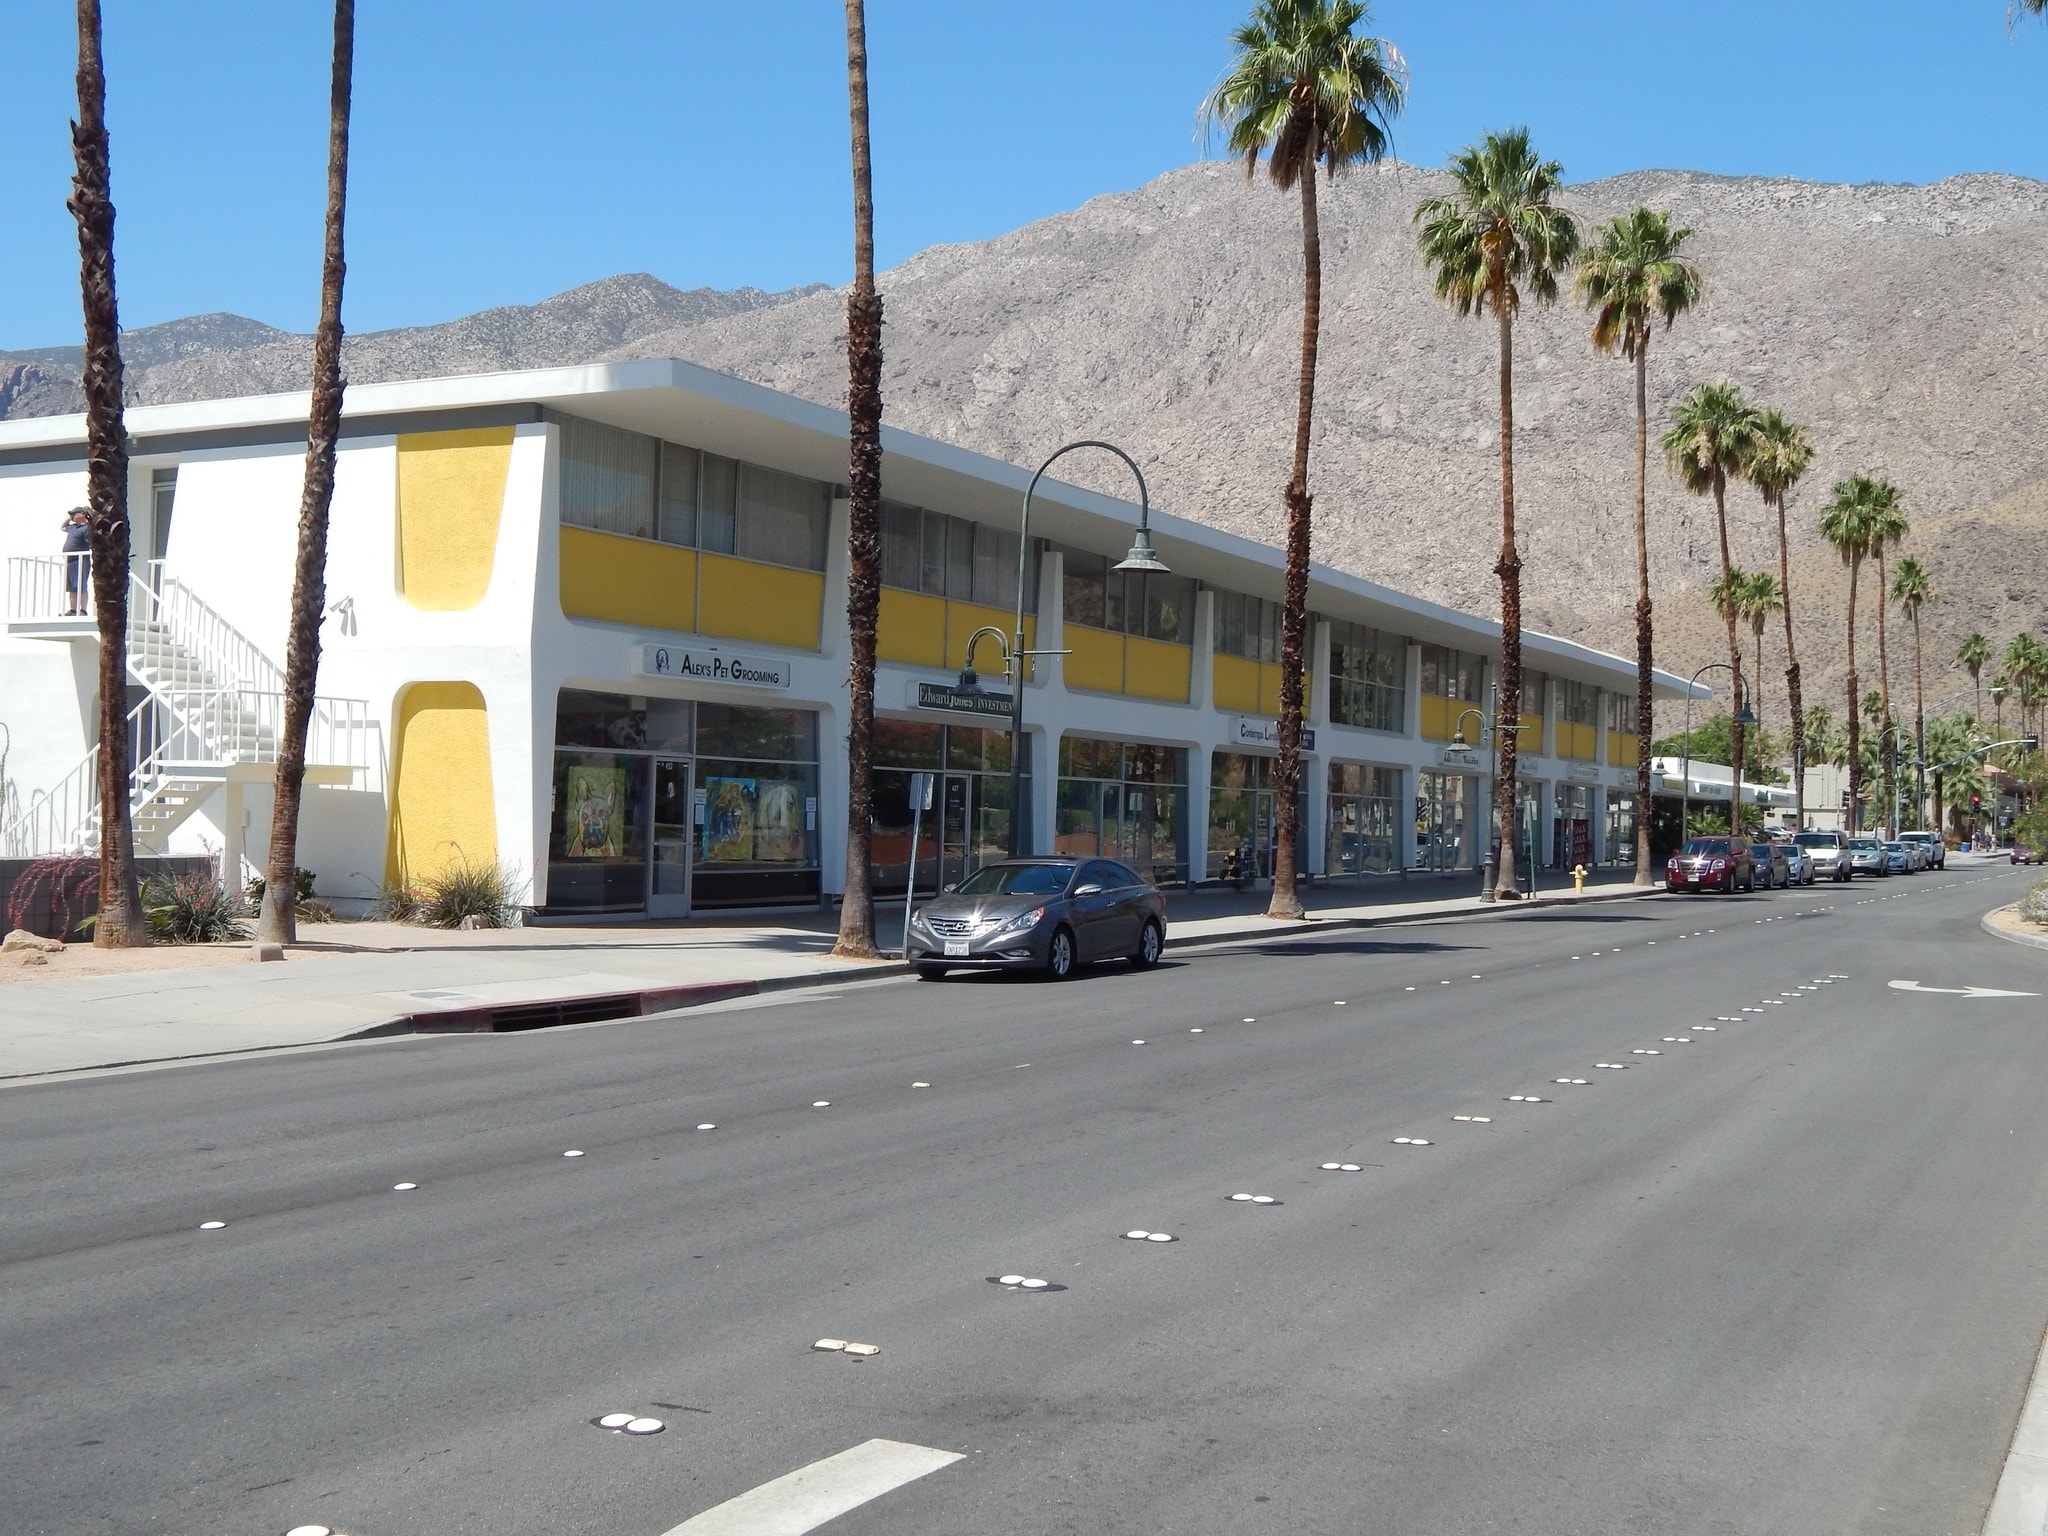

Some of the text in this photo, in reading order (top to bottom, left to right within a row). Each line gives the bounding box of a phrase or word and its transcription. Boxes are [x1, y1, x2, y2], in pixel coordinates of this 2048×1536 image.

[681, 654, 779, 684] ALEX'S PET GROOMING
[920, 685, 950, 705] Edward
[977, 698, 1014, 712] INVESTMEN
